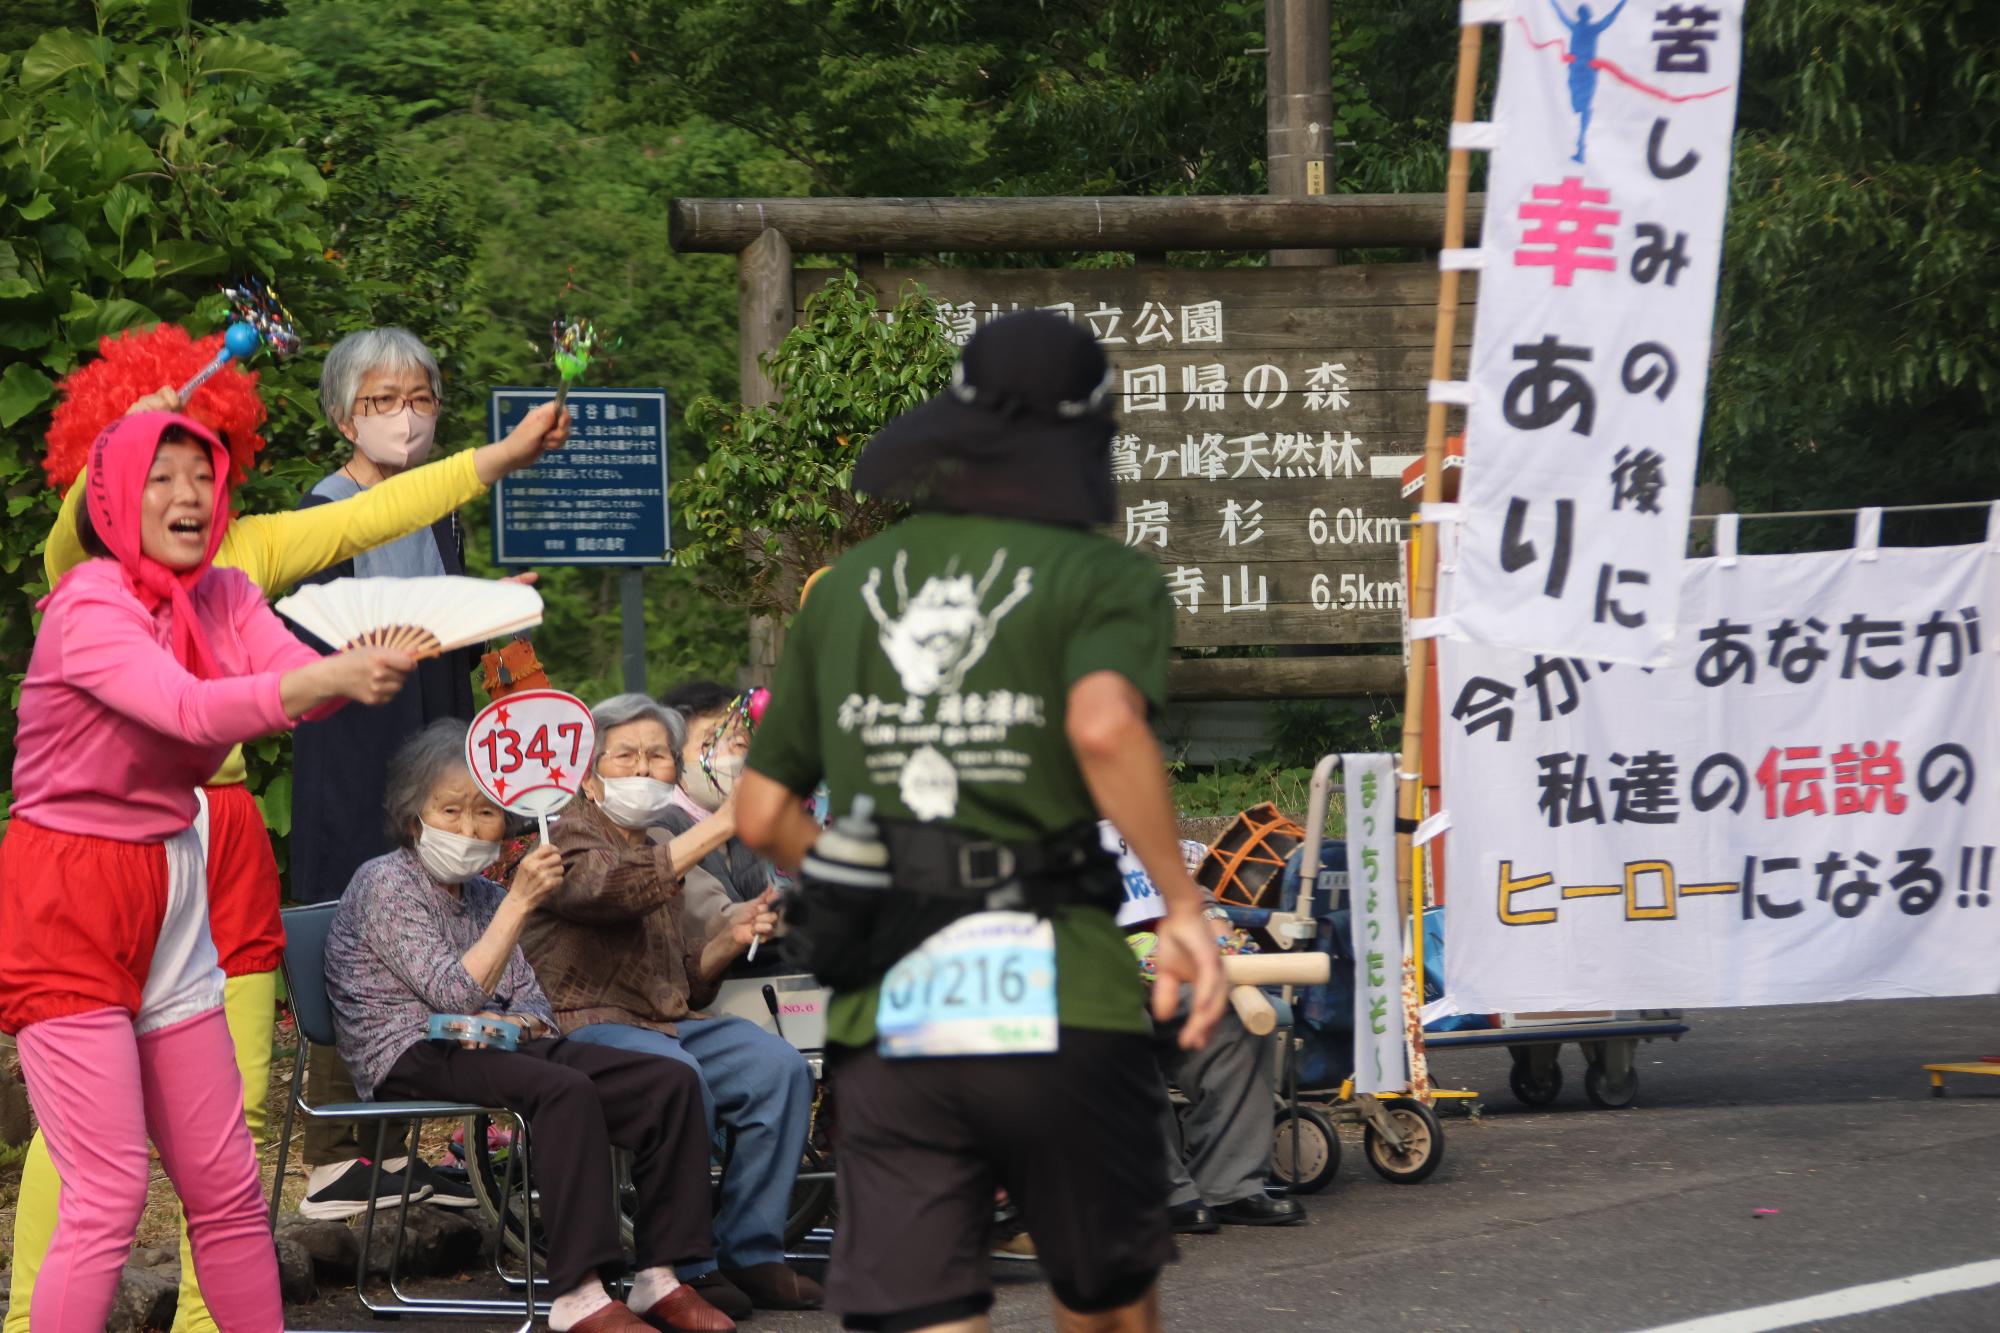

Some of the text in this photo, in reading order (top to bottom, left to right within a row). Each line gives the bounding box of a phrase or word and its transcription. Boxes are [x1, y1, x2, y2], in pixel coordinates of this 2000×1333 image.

[1591, 4, 1721, 629] 苦しみの後に
[1123, 361, 1350, 413] 回帰の森
[1500, 176, 1621, 599] 幸あり
[1308, 507, 1401, 546] 6.0km
[1311, 572, 1401, 611] 6.5km
[1695, 606, 1983, 688] あなたが
[478, 722, 584, 774] 1347
[1536, 740, 1976, 828] 私達の伝説の
